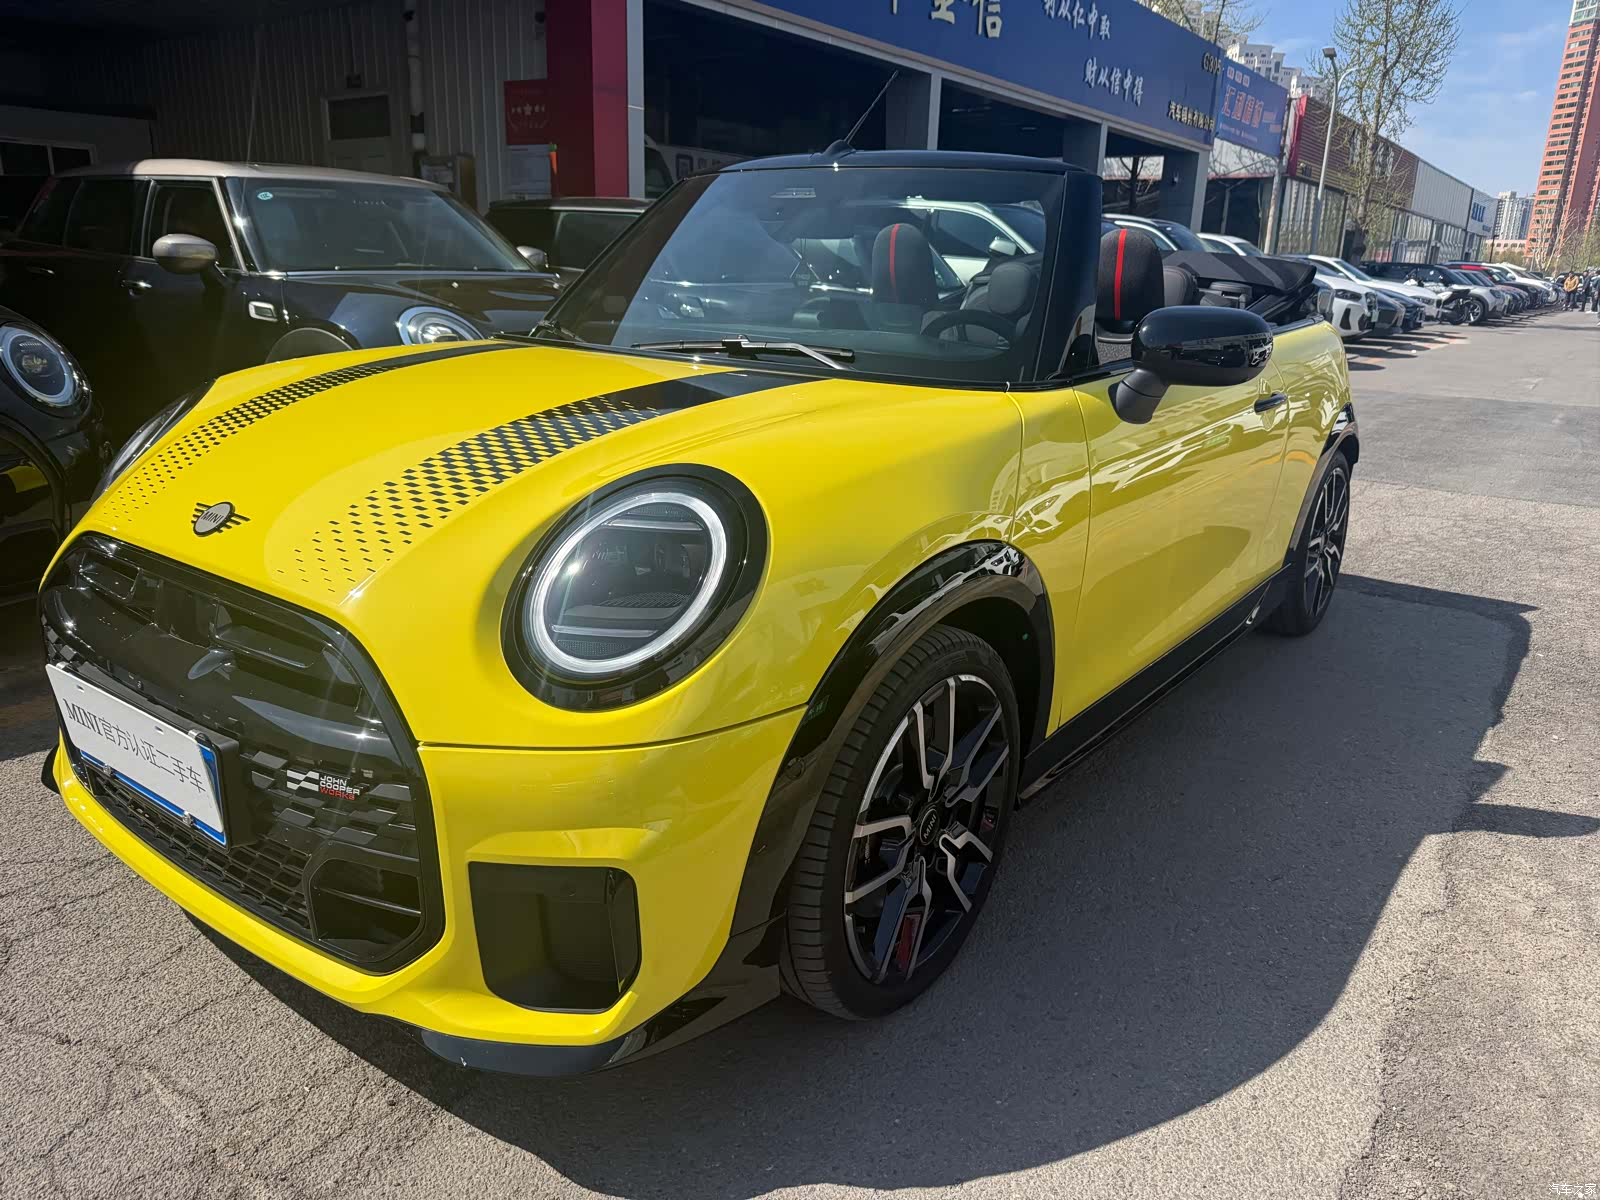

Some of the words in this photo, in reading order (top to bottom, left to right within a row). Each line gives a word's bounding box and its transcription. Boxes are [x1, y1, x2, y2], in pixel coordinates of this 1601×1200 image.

[1084, 57, 1144, 106] 财从信中得
[200, 510, 224, 524] MINI
[320, 775, 348, 787] JOHN
[320, 781, 360, 796] COOPER
[320, 787, 355, 801] WORKS
[923, 813, 937, 839] MINI
